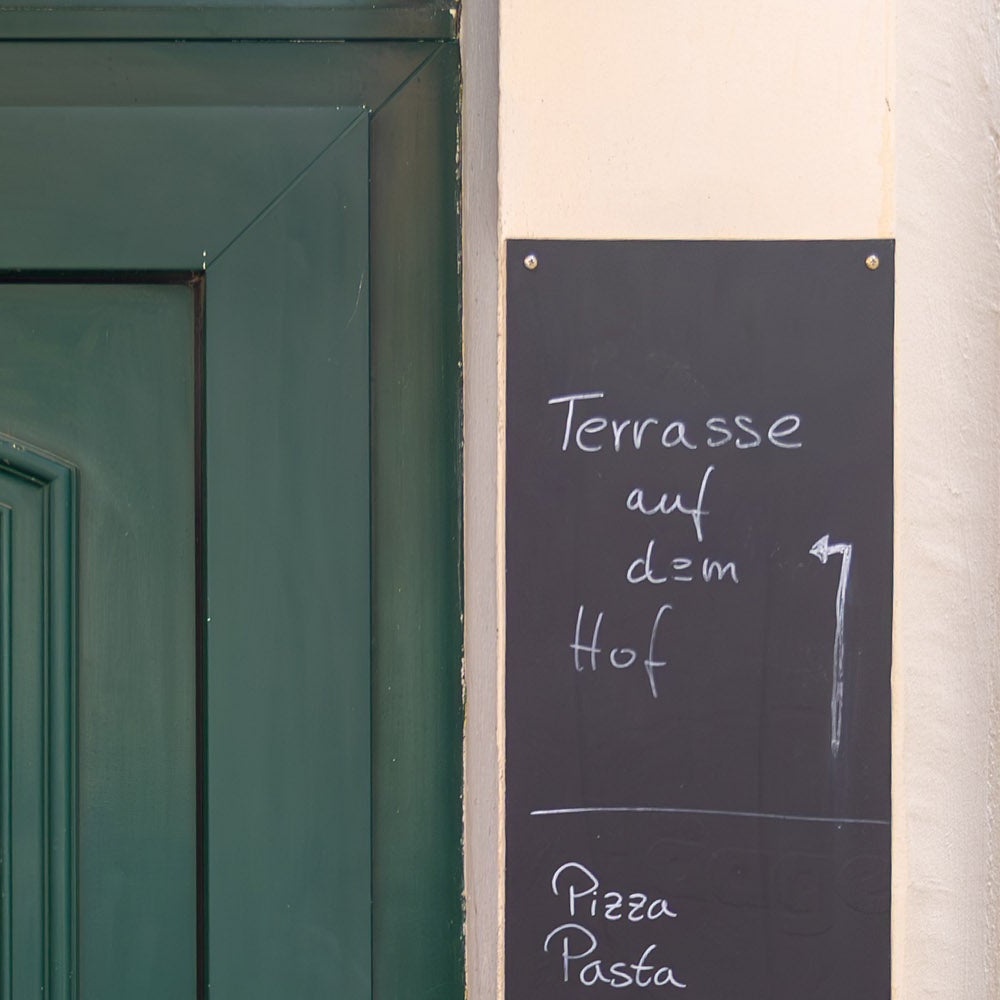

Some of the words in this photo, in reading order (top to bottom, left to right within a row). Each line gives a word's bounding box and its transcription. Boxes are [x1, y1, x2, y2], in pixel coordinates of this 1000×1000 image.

[548, 392, 803, 452] Terrasse
[626, 465, 715, 543] auf
[626, 539, 739, 584] dem
[569, 604, 673, 699] Hof
[551, 861, 678, 921] Pizza
[543, 923, 687, 989] Pasta
